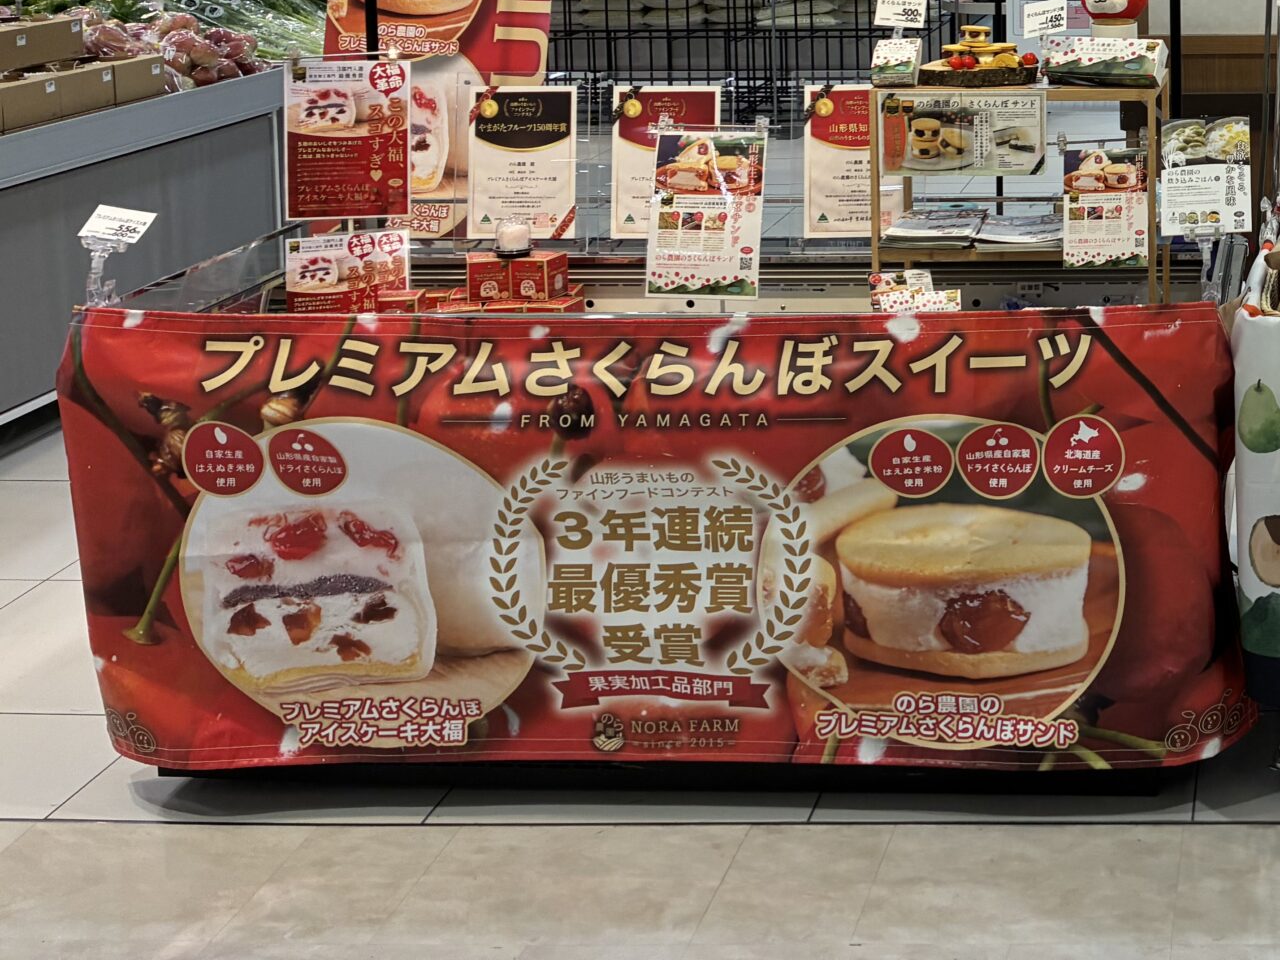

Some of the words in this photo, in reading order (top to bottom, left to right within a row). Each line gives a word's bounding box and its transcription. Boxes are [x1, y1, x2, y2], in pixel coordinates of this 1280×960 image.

[377, 24, 426, 39] のら農園の
[338, 36, 461, 55] プレミムさくらんぼサンド
[372, 63, 401, 79] 大福
[375, 78, 403, 92] 革命
[968, 99, 1037, 109] さくらんぼサンド
[201, 334, 1094, 398] プレミアムさくらんぼスイーツ
[520, 414, 595, 428] FROM
[618, 413, 769, 428] YAMAGATA
[205, 450, 244, 459] 自家生産
[892, 455, 932, 465] 自家生産
[965, 448, 1031, 461] 山形県産自家製
[1064, 449, 1102, 460] 北海道産
[195, 463, 256, 473] はえぬき米粉
[278, 464, 344, 475] ドライさくらんぼ
[883, 465, 943, 476] はえぬき米粉
[966, 463, 1033, 474] ドライさくらんぼ
[1052, 463, 1114, 474] クリームチーズ
[216, 477, 236, 488] 使用
[302, 477, 322, 488] 使用
[590, 471, 695, 485] 山形うまいもの
[904, 478, 924, 488] 使用
[988, 478, 1008, 489] 使用
[1072, 478, 1093, 489] 使用
[556, 486, 734, 501] ファインフードコンテスト
[553, 505, 755, 553] 3年連続
[547, 561, 754, 614] 最優秀賞
[601, 622, 706, 668] 受賞
[588, 674, 734, 696] 果実加工品部門
[280, 698, 482, 723] プレミアムさくらんぼ
[895, 693, 1000, 715] のら農園の
[299, 720, 465, 744] アイスケーキ大福
[631, 719, 682, 734] NORA
[690, 718, 740, 733] FARM
[816, 711, 1078, 748] プレミアムさくらんぼサンド
[690, 737, 726, 749] 2015
